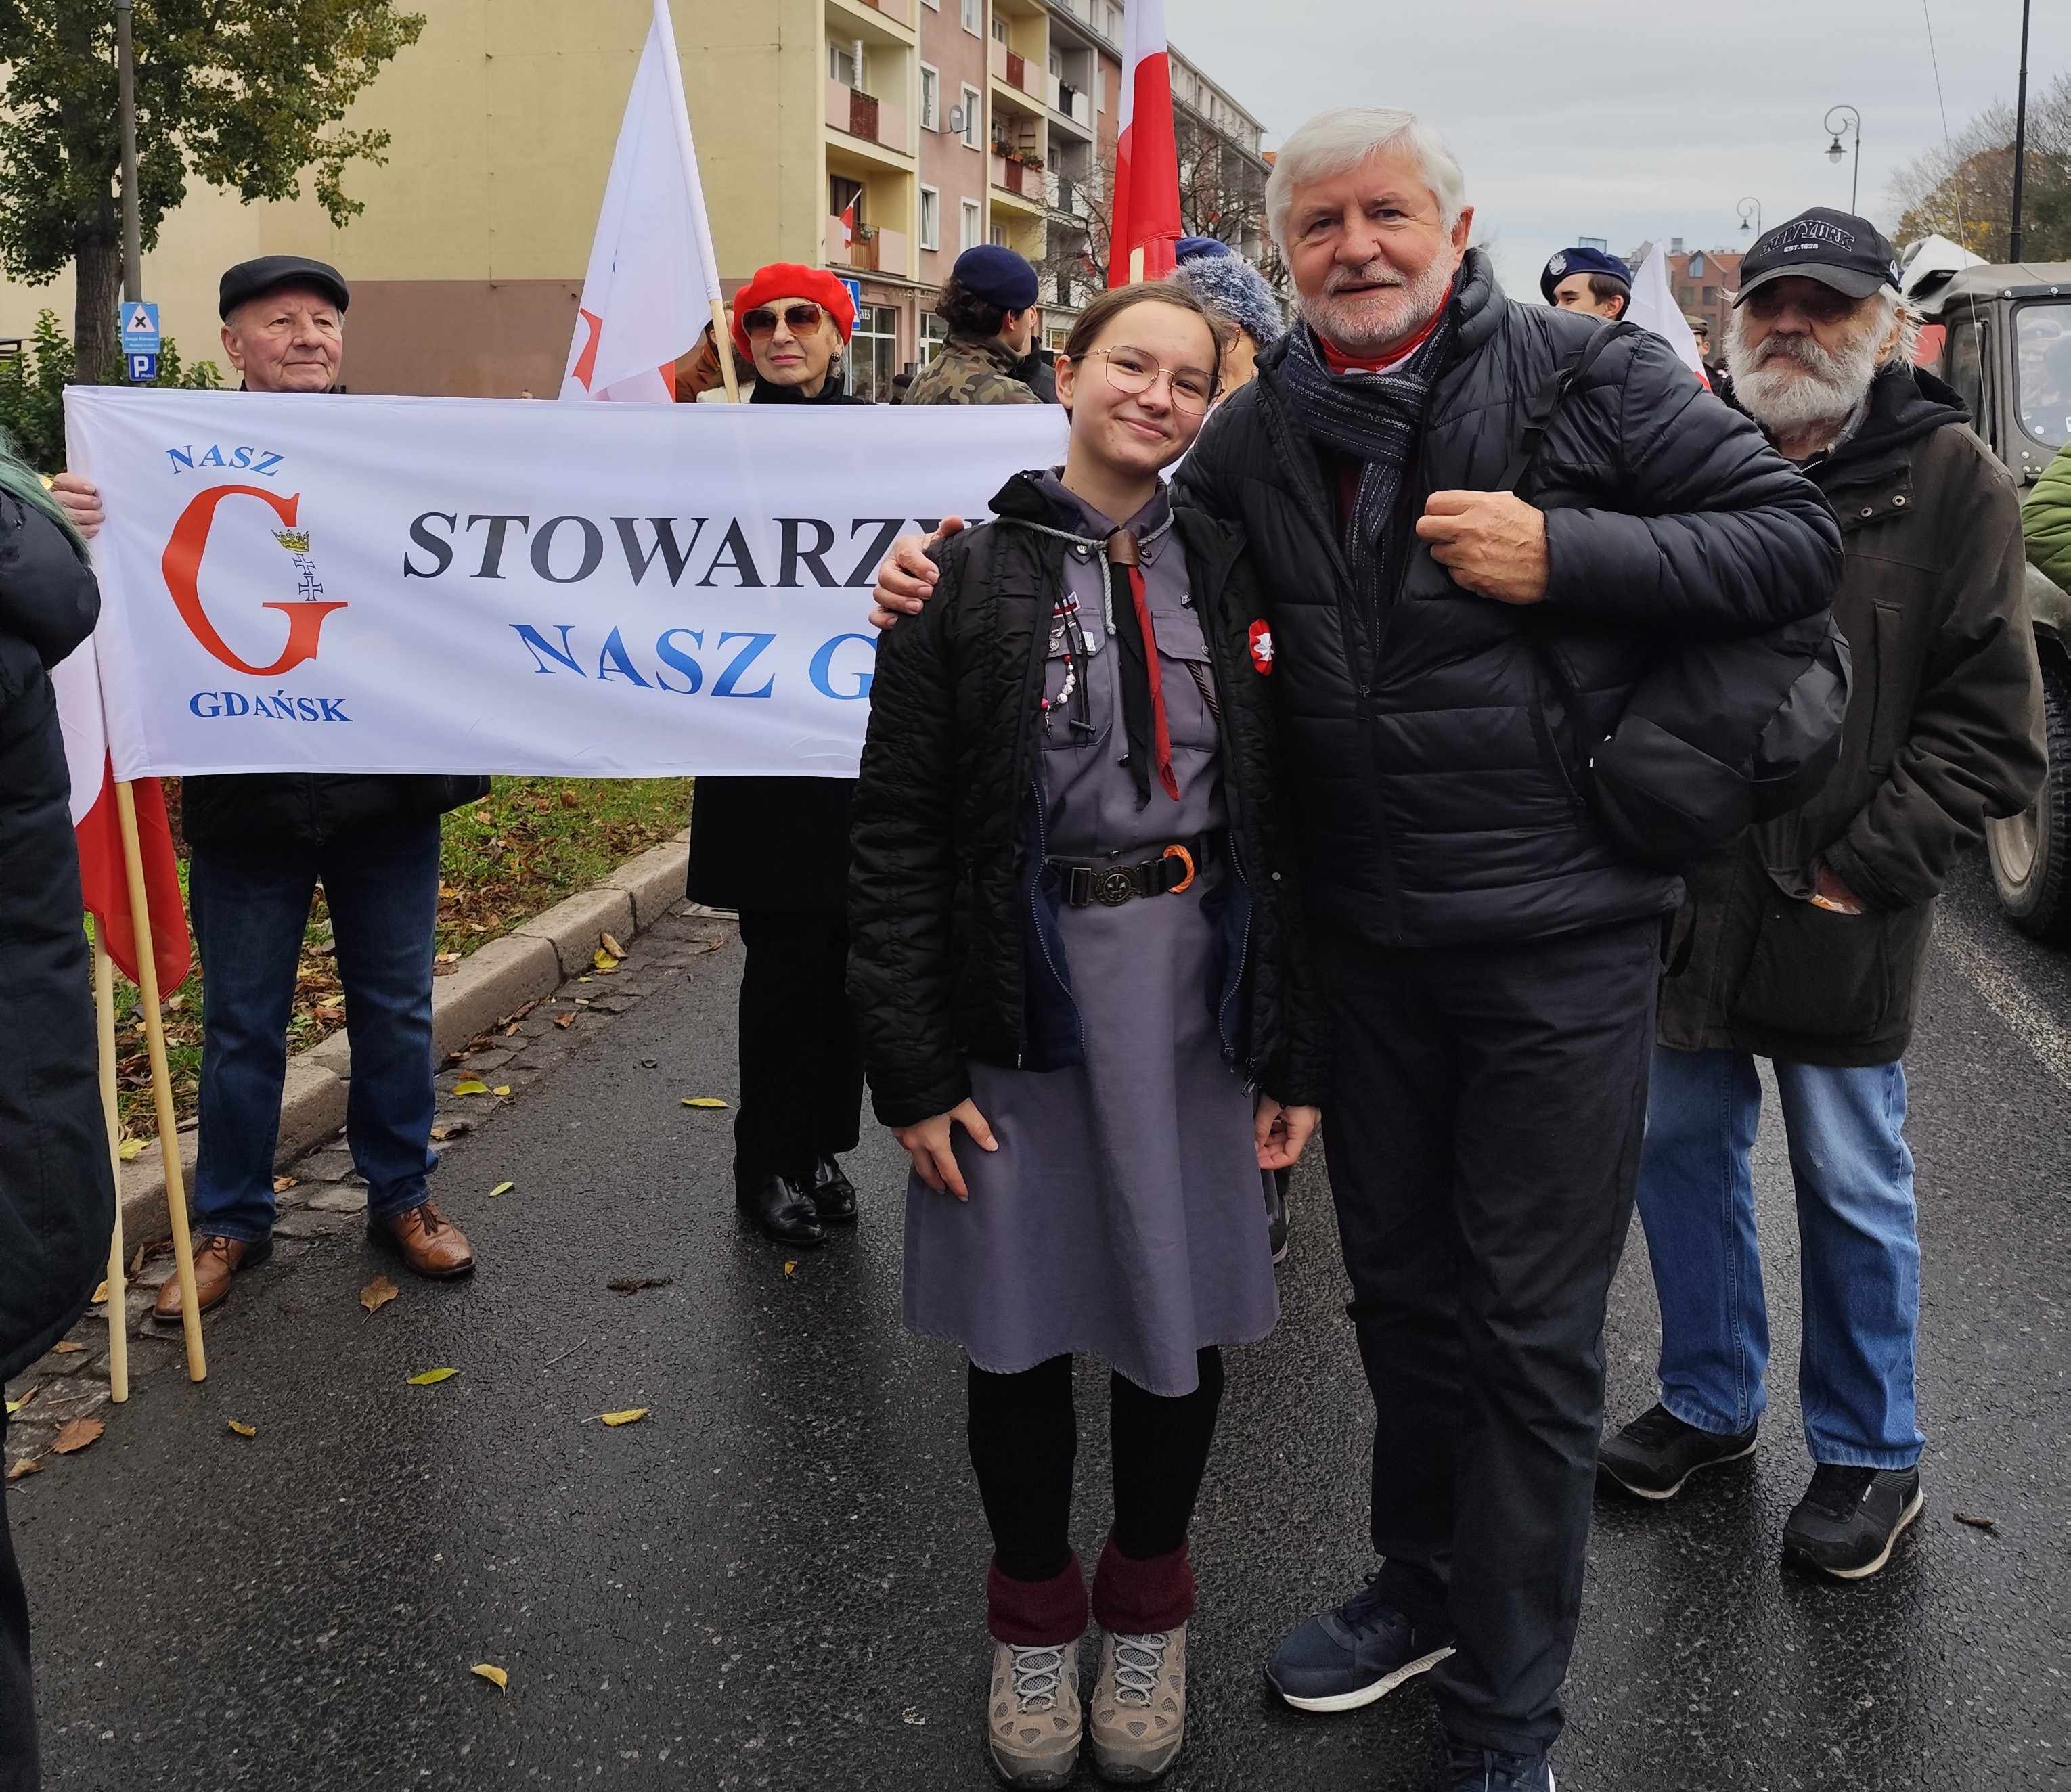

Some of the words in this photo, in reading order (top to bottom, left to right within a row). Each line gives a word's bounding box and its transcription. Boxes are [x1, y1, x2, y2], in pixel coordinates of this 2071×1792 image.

[1797, 219, 1854, 252] YORK
[134, 355, 148, 378] P
[166, 445, 285, 476] NASZ
[508, 624, 778, 698] NASZ
[189, 688, 353, 723] GDAŃSK
